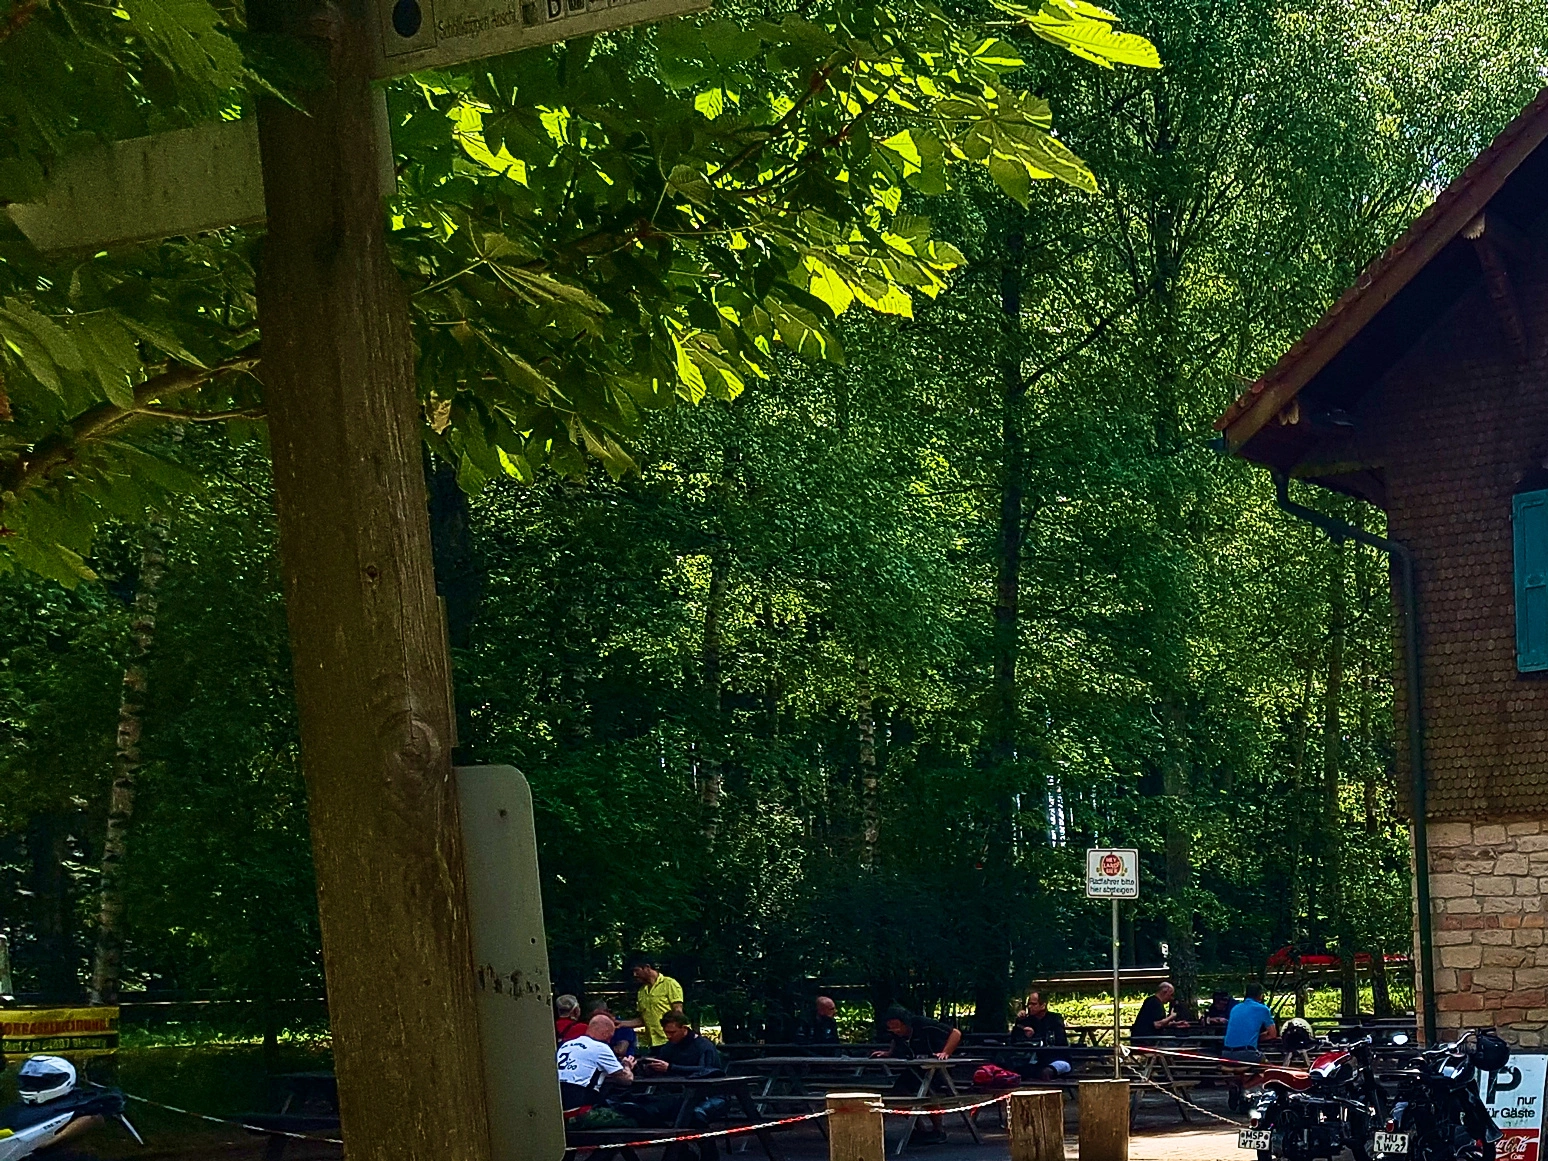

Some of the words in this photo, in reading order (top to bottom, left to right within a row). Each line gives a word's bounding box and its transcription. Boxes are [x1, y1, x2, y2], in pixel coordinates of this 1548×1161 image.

[1486, 1066, 1522, 1104] P
[1517, 1096, 1537, 1105] nur
[1501, 1107, 1535, 1118] Gäste
[1245, 1130, 1263, 1140] MSP
[1384, 1133, 1398, 1143] HU
